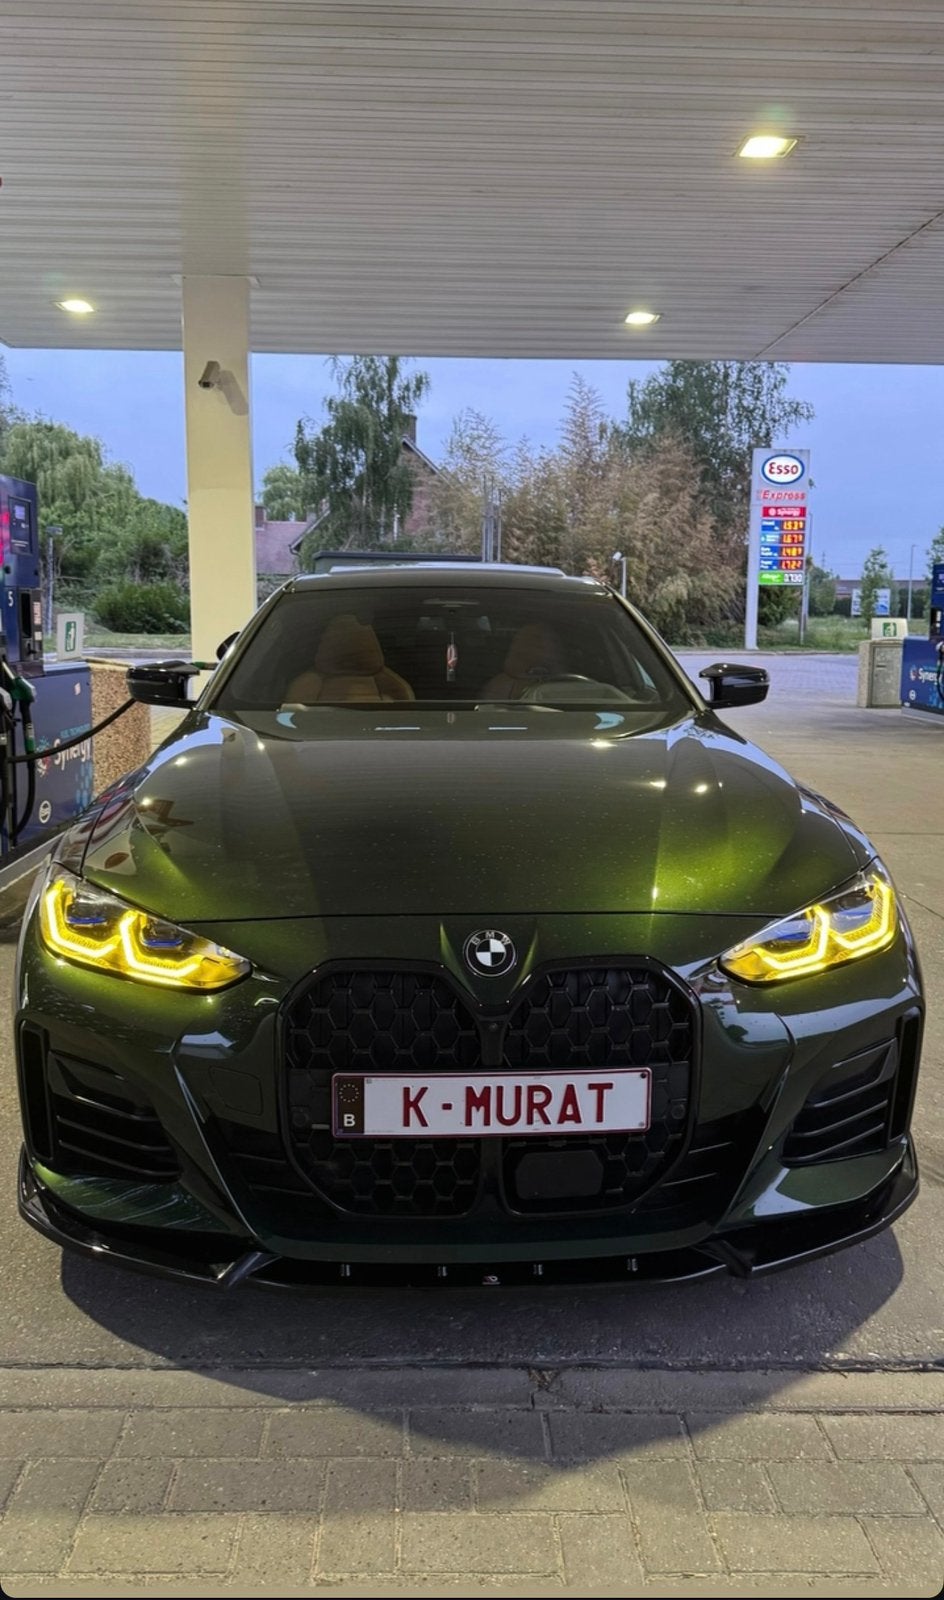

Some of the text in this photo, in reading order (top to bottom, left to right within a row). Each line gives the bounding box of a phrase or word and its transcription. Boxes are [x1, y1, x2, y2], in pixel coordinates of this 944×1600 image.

[768, 462, 799, 475] Esso
[762, 489, 806, 502] Express
[777, 508, 801, 517] Synergy
[7, 591, 14, 607] 5
[471, 931, 511, 946] BMW
[343, 1113, 356, 1127] B
